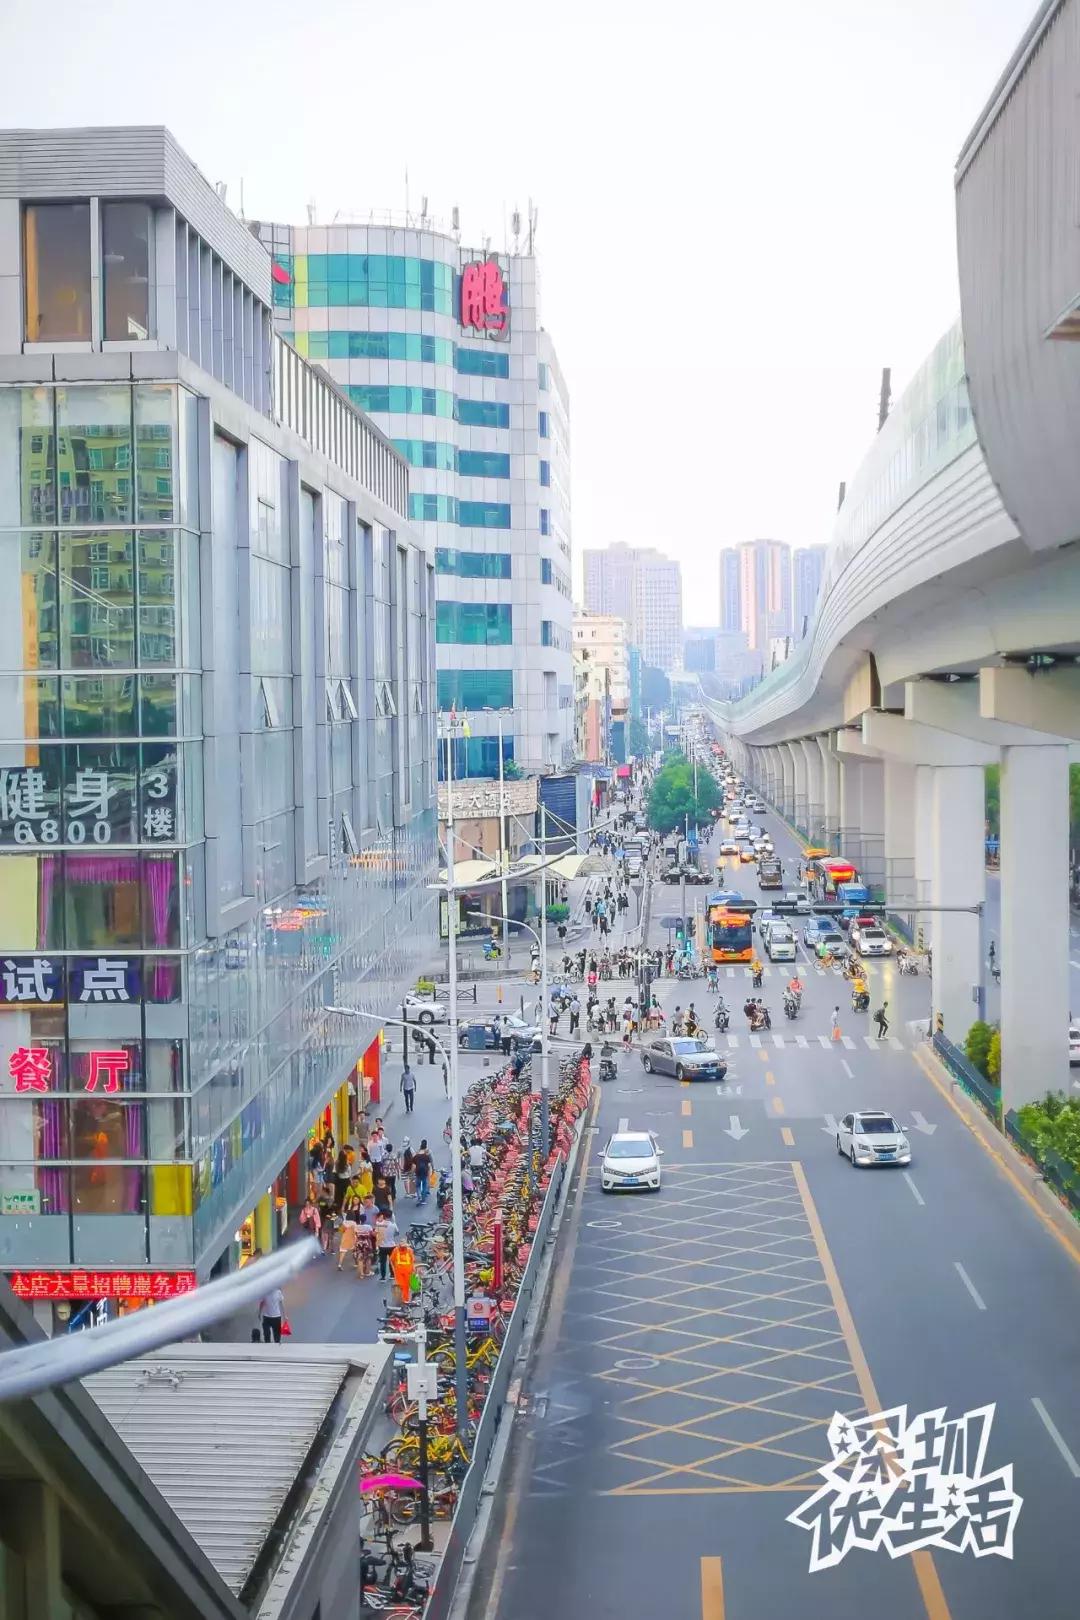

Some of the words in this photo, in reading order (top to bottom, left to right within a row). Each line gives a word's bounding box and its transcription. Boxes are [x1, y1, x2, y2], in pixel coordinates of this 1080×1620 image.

[0, 768, 117, 820] 健身
[3, 958, 130, 1001] 试点
[9, 1048, 128, 1092] 餐厅
